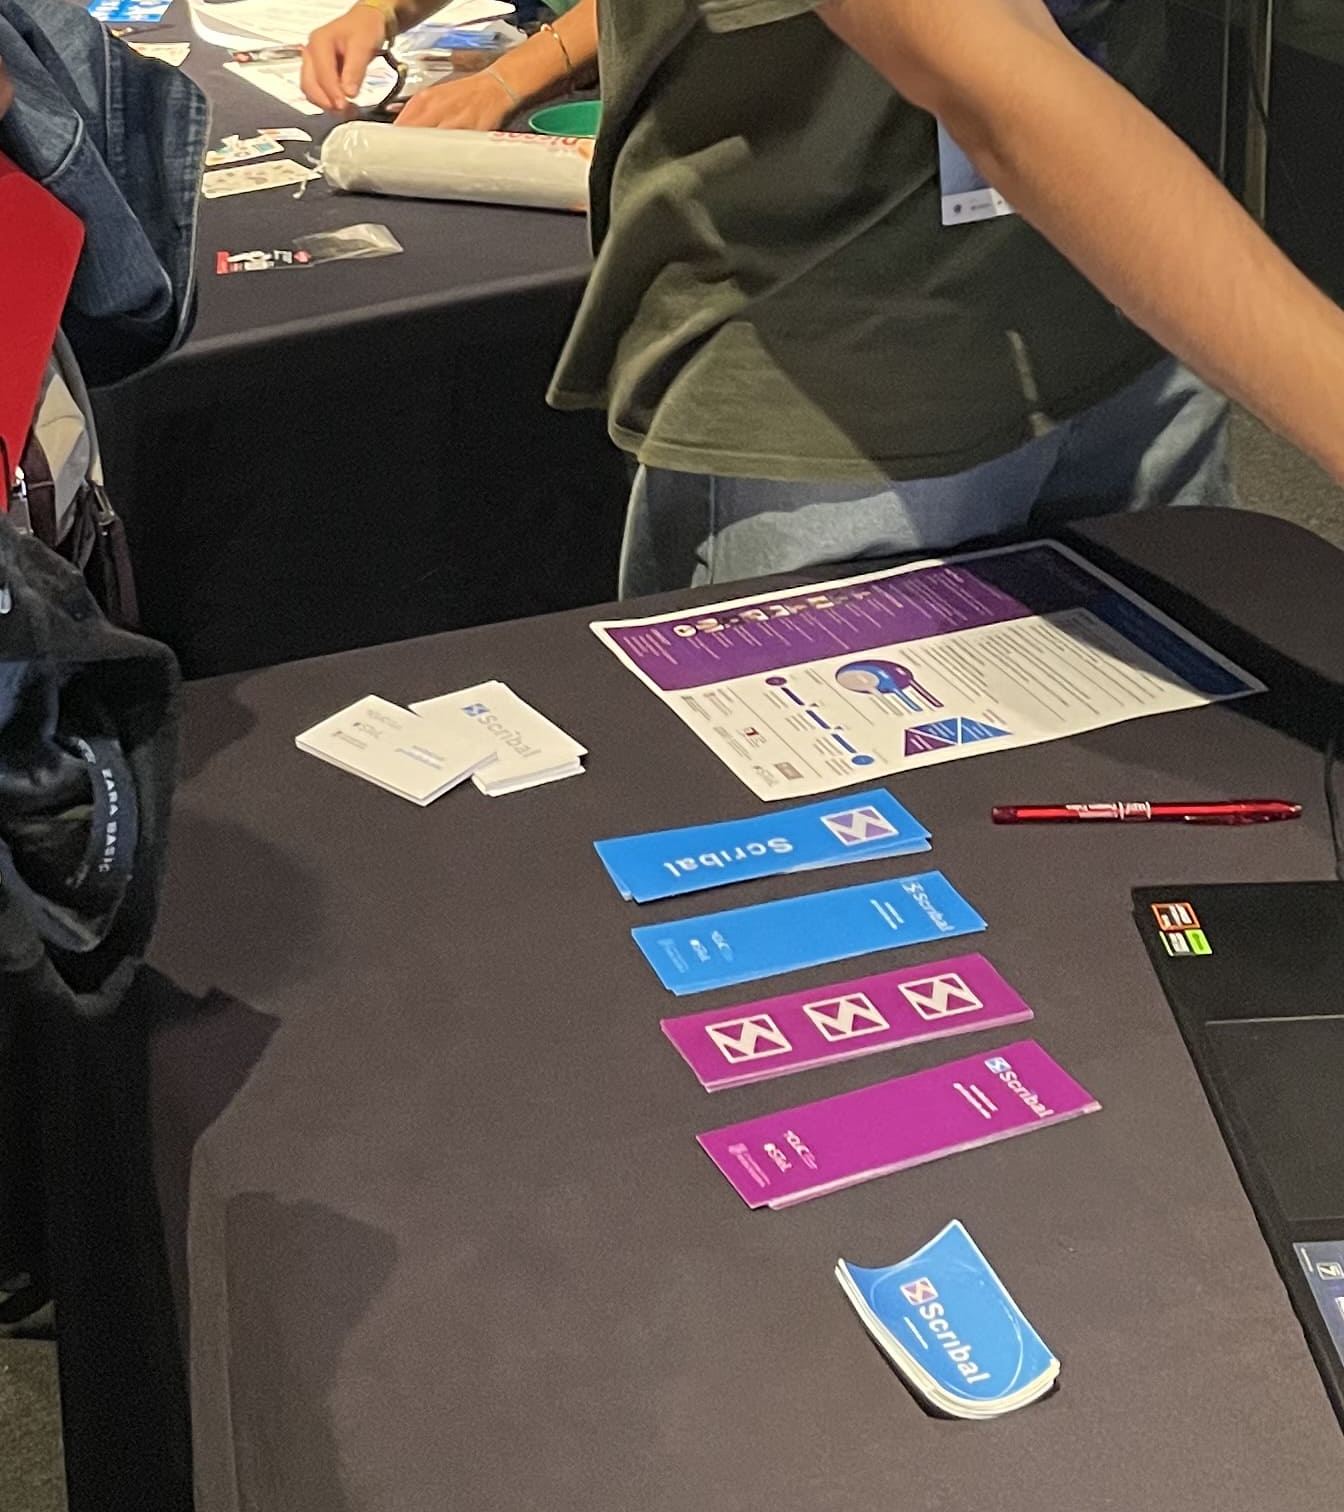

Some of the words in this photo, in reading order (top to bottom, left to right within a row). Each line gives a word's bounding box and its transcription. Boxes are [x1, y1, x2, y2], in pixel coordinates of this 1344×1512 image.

[478, 715, 542, 759] Scribal
[664, 837, 794, 879] Scribal
[914, 890, 954, 932] Scribal
[999, 1069, 1055, 1118] Scribal
[919, 1300, 992, 1385] Scribal
